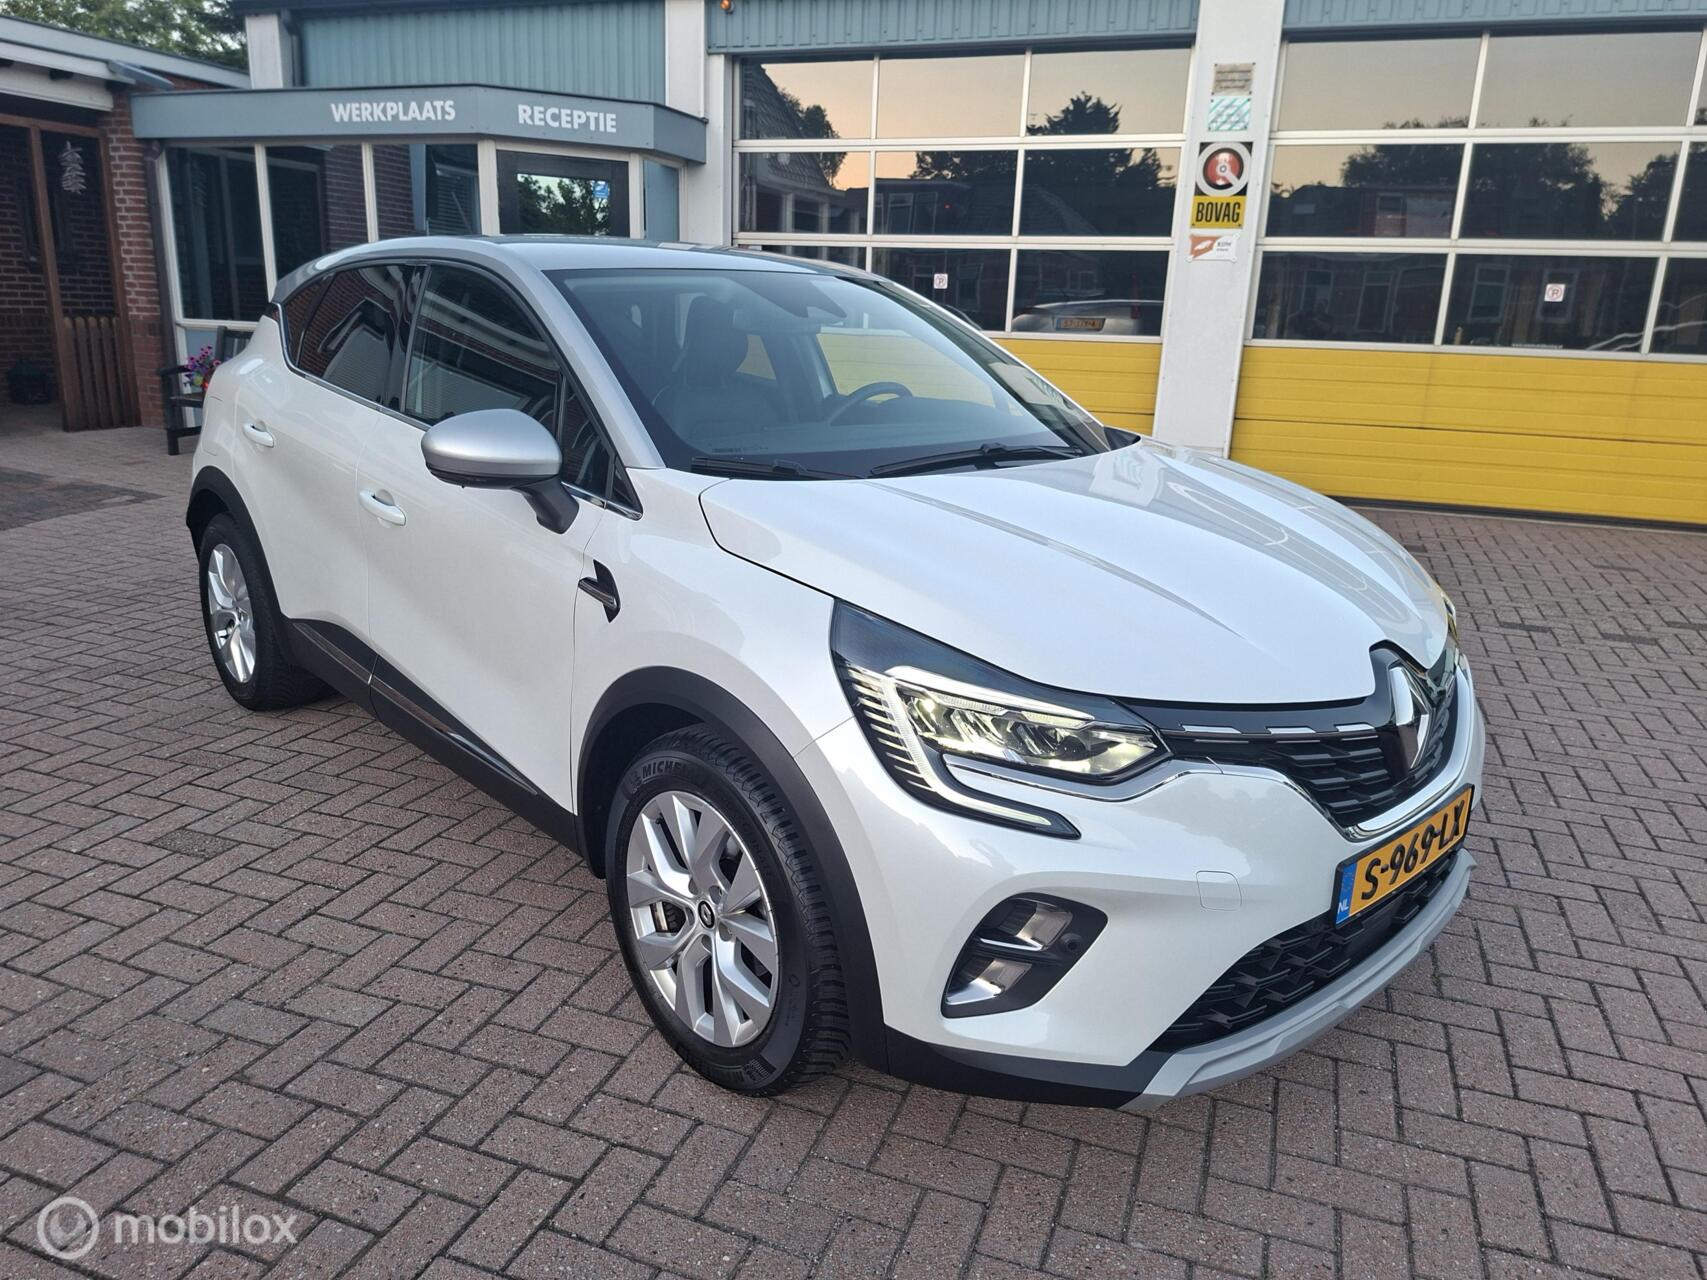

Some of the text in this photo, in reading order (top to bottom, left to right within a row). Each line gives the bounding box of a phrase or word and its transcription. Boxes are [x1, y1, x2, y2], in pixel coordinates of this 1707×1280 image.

[330, 100, 456, 123] WERKPLAATS
[518, 104, 617, 133] RECEPTIE
[1195, 202, 1241, 223] BOVAG
[1361, 800, 1465, 900] S-969-LX
[1337, 899, 1350, 914] NL
